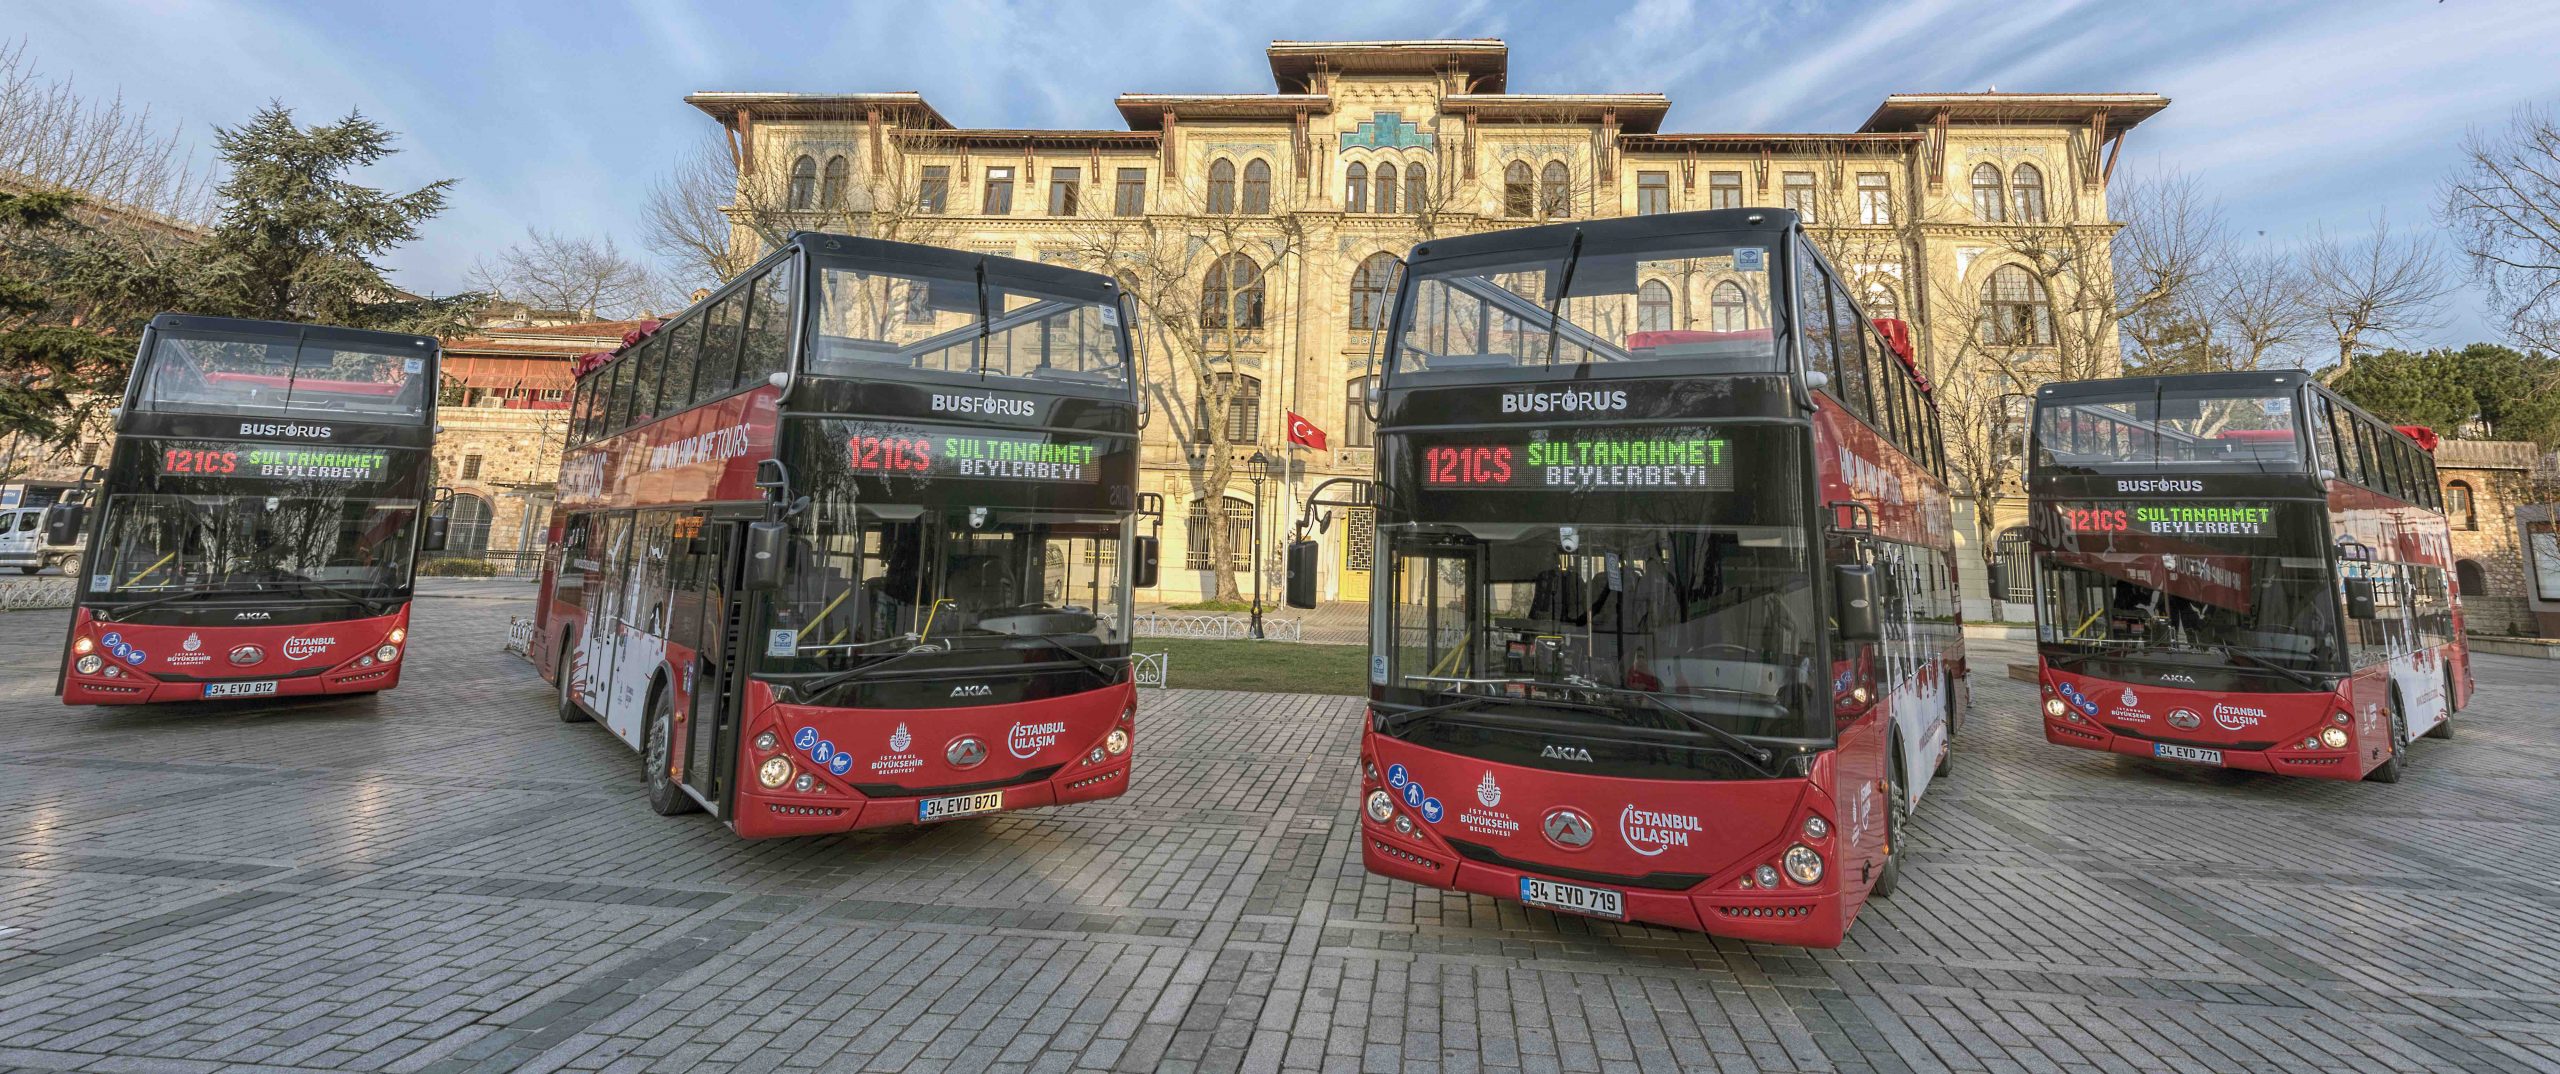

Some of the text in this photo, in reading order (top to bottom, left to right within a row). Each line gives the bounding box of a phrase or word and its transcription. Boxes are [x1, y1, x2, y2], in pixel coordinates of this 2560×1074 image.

[932, 393, 1035, 416] BUSFORUS
[1502, 387, 1627, 413] BUSFORUS
[240, 423, 332, 438] BUSFORUS
[716, 422, 750, 460] TOURS
[166, 449, 384, 473] 121CS SULTANAHMET
[849, 436, 1093, 471] 121CS SULTANAHMET
[1426, 440, 1724, 483] 121CS SULTANAHMET
[2117, 476, 2203, 492] BUSFORUS
[2068, 508, 2269, 531] 121CS SULTANAHMET
[234, 612, 271, 620] AKIA
[290, 636, 336, 646] İSTANBUL
[289, 645, 326, 656] ULAŞIM
[2160, 673, 2195, 684] AKIA
[212, 682, 273, 695] 34 EVD 812
[950, 685, 992, 698] AKIA
[2218, 703, 2266, 718] İSTANBUL
[2219, 715, 2258, 727] ULAŞIM
[1015, 722, 1066, 737] İSTANBUL
[1014, 735, 1055, 751] ULAŞIM
[1540, 745, 1593, 763] AKIA
[2160, 745, 2217, 762] 34 EVD 771
[871, 758, 923, 770] BÜYÜKŞEHİR
[928, 801, 943, 815] 34
[948, 797, 970, 813] EVD
[975, 794, 997, 809] 870
[1460, 813, 1519, 831] BÜYÜKŞEHİR
[1629, 804, 1702, 831] İSTANBUL
[1469, 825, 1511, 837] BELEDİYESİ
[1629, 827, 1688, 849] ULAŞIM
[1530, 881, 1548, 900] 34
[1555, 885, 1583, 905] EVD
[1590, 890, 1616, 911] 719
